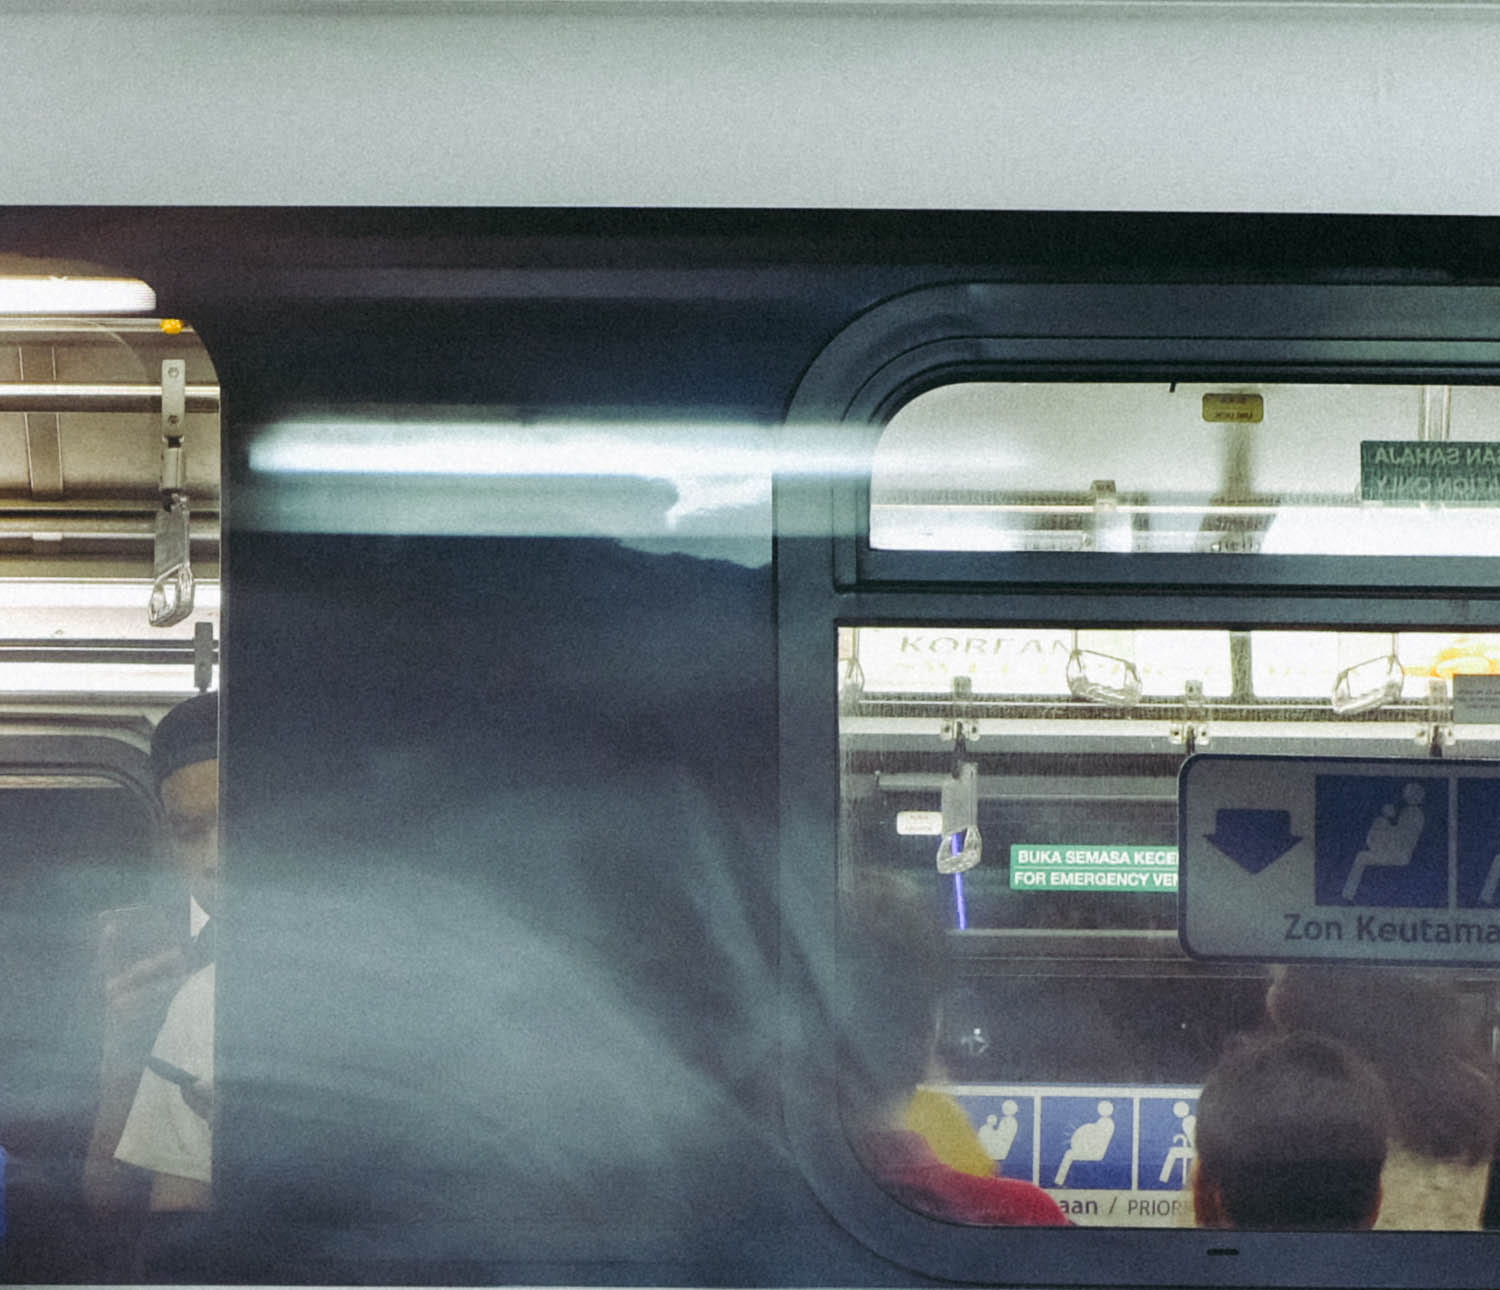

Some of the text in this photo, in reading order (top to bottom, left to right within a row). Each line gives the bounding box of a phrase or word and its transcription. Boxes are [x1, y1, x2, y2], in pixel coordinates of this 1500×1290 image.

[1018, 850, 1179, 865] BUKA SEMASA KECE
[1014, 872, 1046, 885] FOR
[1049, 872, 1149, 886] EMERGENCY
[1283, 914, 1343, 941] Zon
